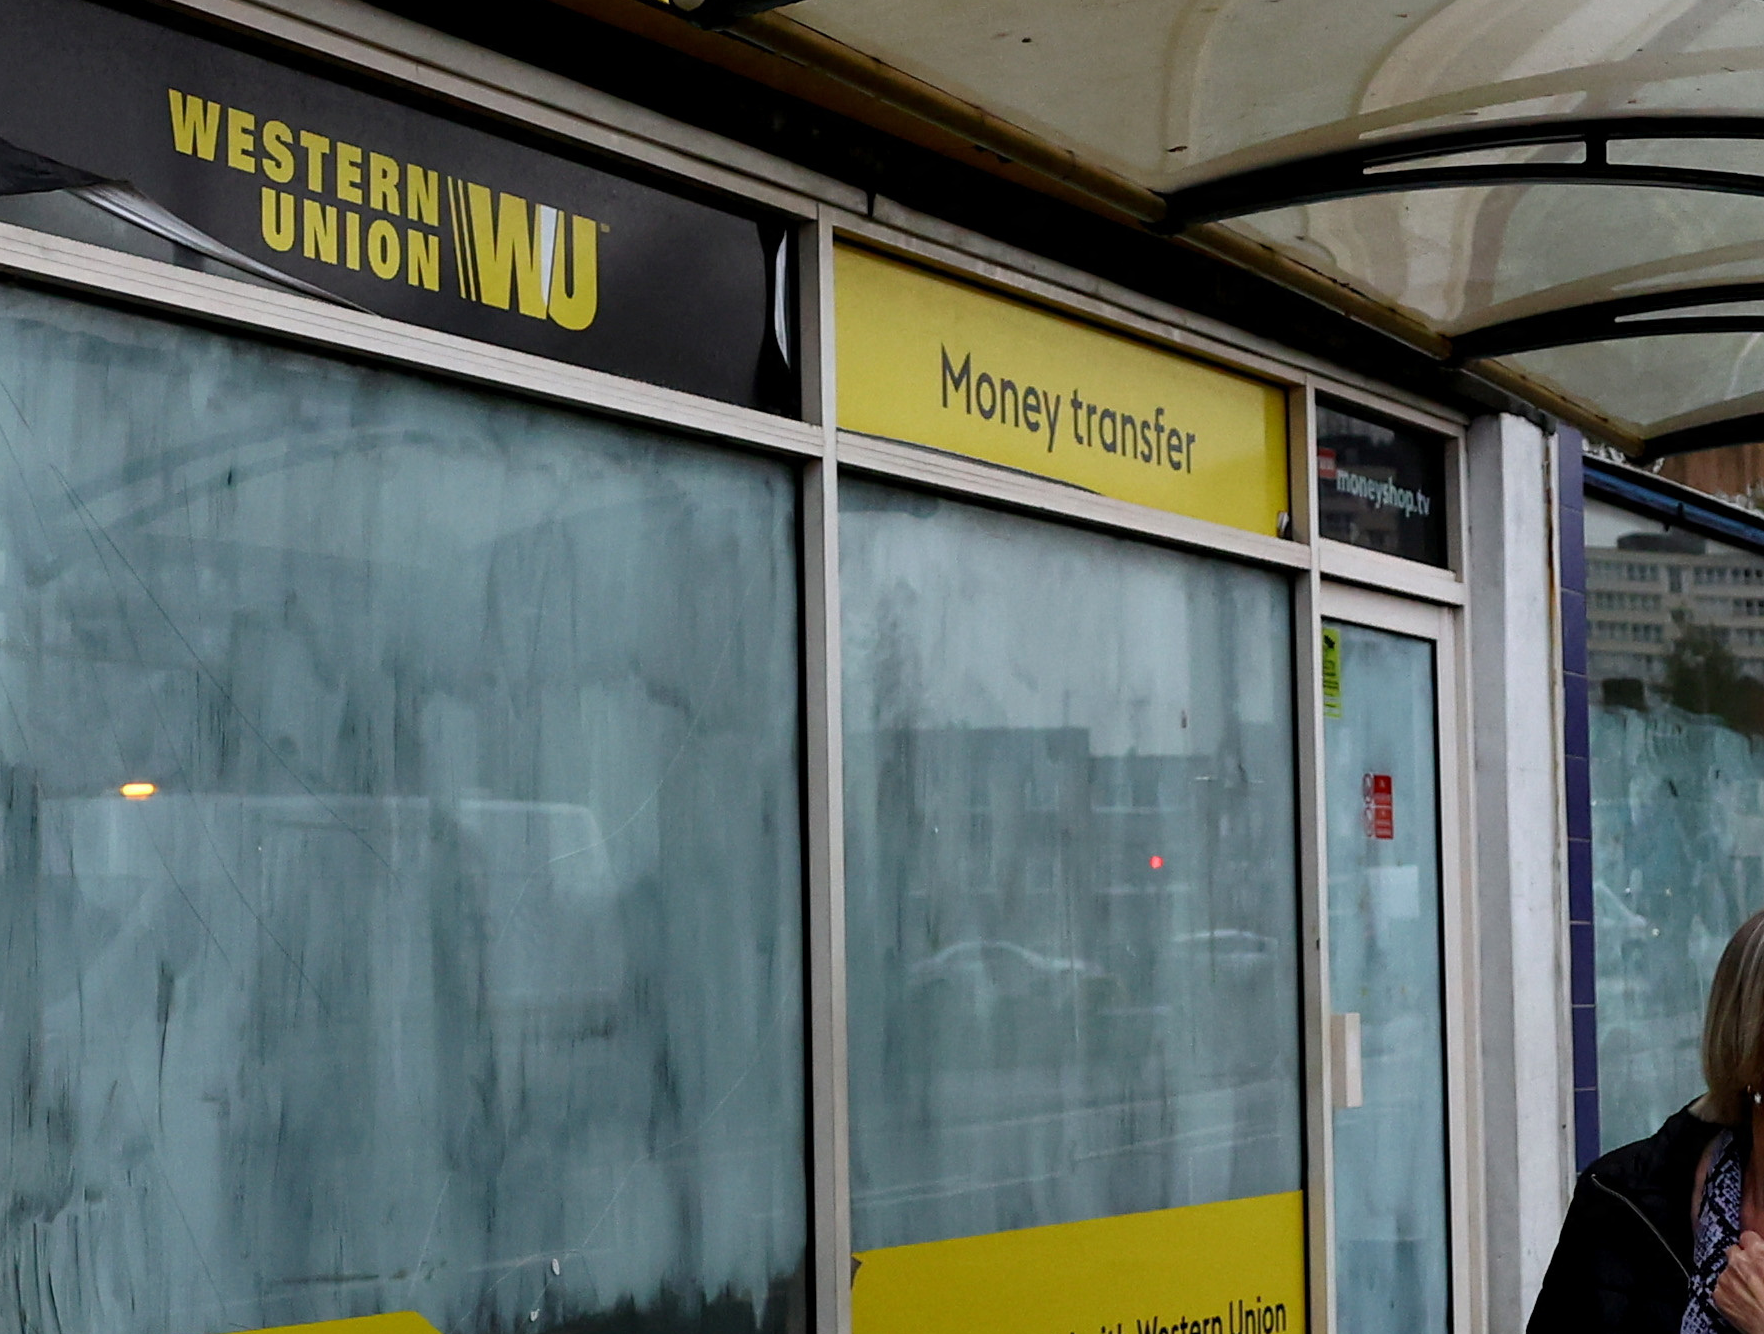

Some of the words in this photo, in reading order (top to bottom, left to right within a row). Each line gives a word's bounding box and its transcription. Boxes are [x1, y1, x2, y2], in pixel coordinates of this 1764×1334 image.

[168, 88, 439, 227] WESTERN
[261, 186, 440, 292] UNION
[940, 343, 1061, 454] Money
[1071, 388, 1196, 474] transfer
